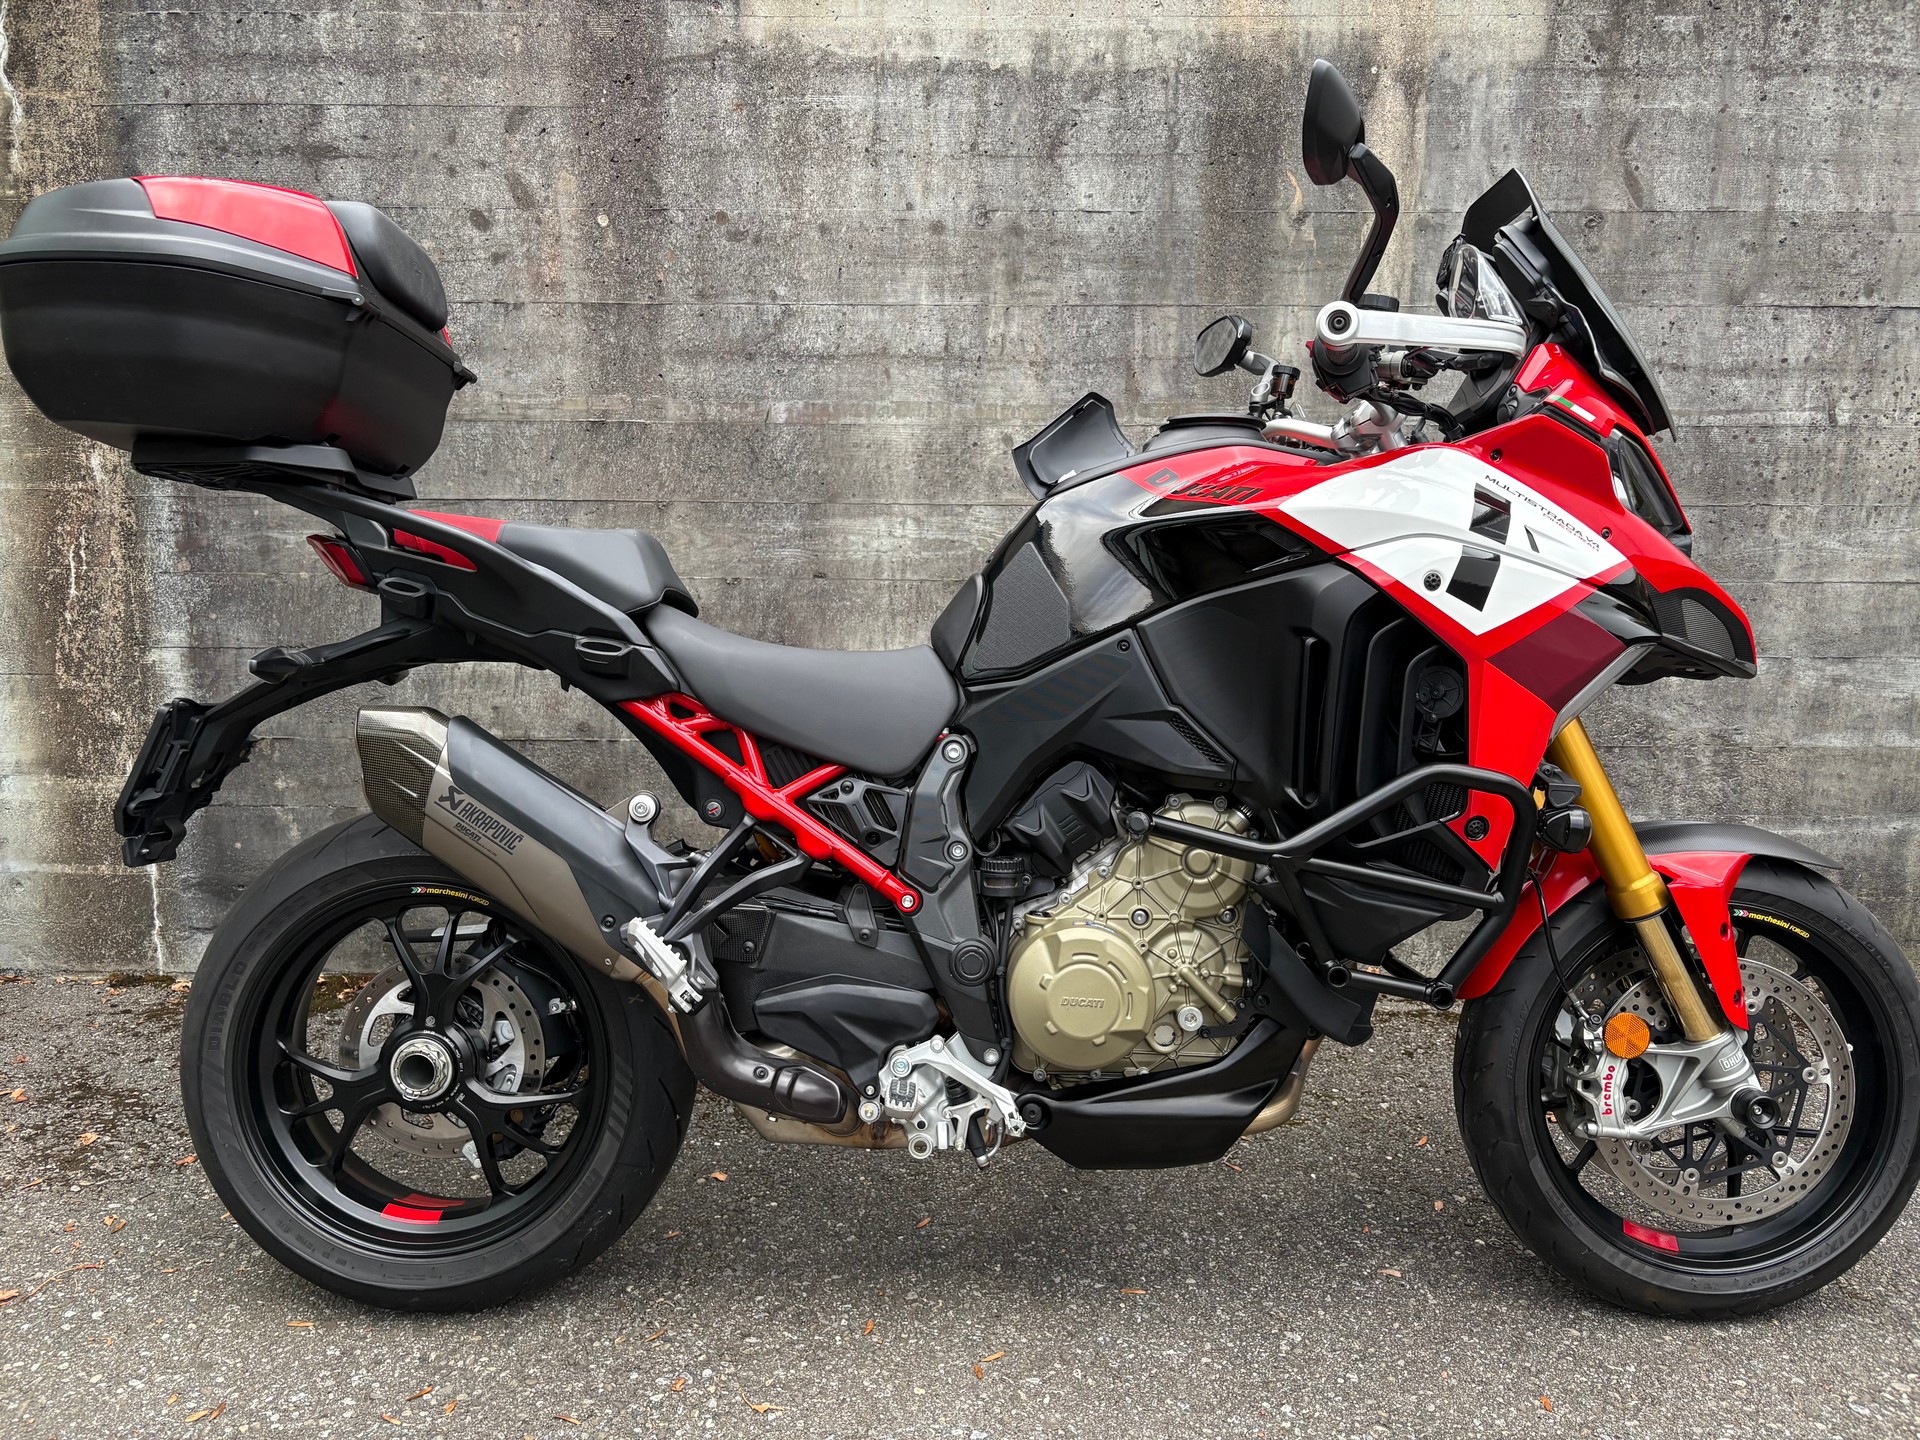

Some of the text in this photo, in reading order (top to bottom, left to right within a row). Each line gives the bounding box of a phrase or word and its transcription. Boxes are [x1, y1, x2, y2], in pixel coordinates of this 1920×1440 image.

[1145, 467, 1266, 503] DUCATI
[455, 822, 482, 842] DUCATI
[426, 887, 490, 906] marchesini FORGED
[1748, 912, 1810, 939] marchesini FORGED
[1060, 996, 1105, 1009] DUCATI
[1722, 1049, 1743, 1069] ÖHLI
[1601, 1065, 1616, 1116] brembo
